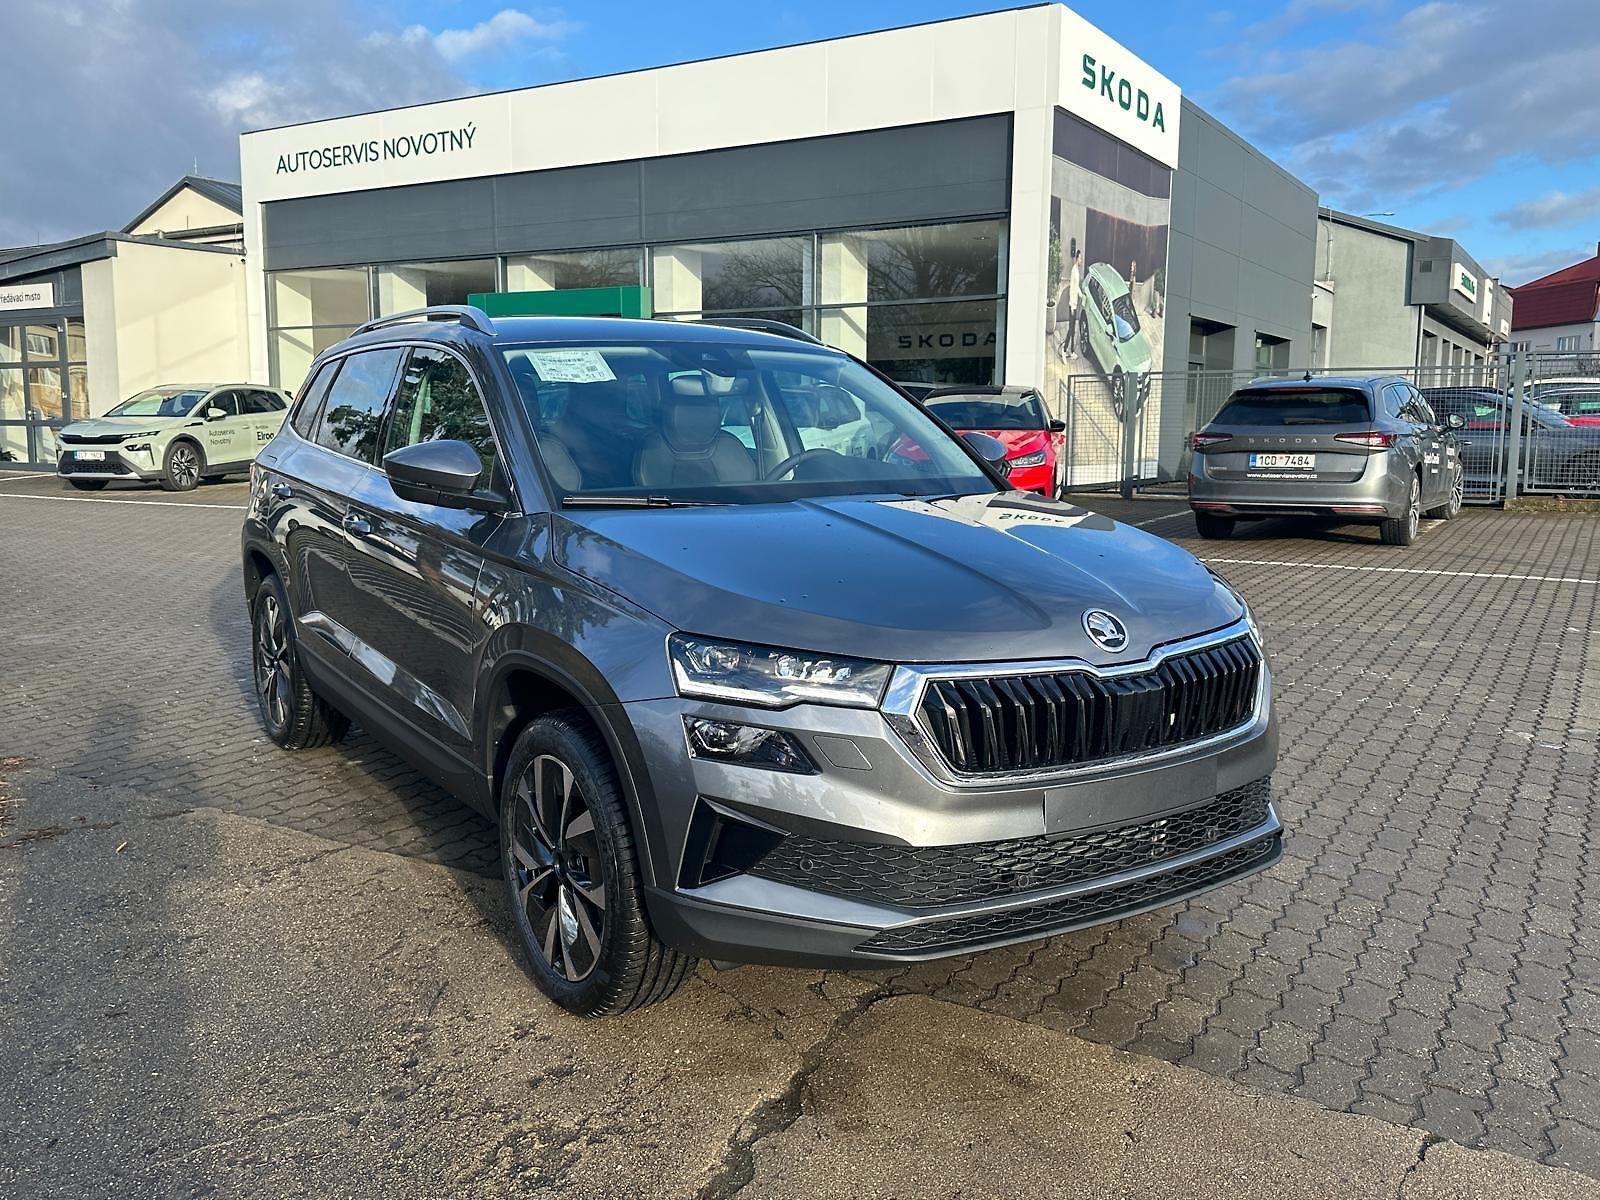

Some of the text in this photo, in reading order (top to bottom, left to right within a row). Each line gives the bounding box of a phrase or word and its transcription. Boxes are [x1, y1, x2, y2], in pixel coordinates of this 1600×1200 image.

[276, 122, 477, 175] AUTOSERVIS NOVOTNÝ
[1284, 456, 1310, 465] 7484
